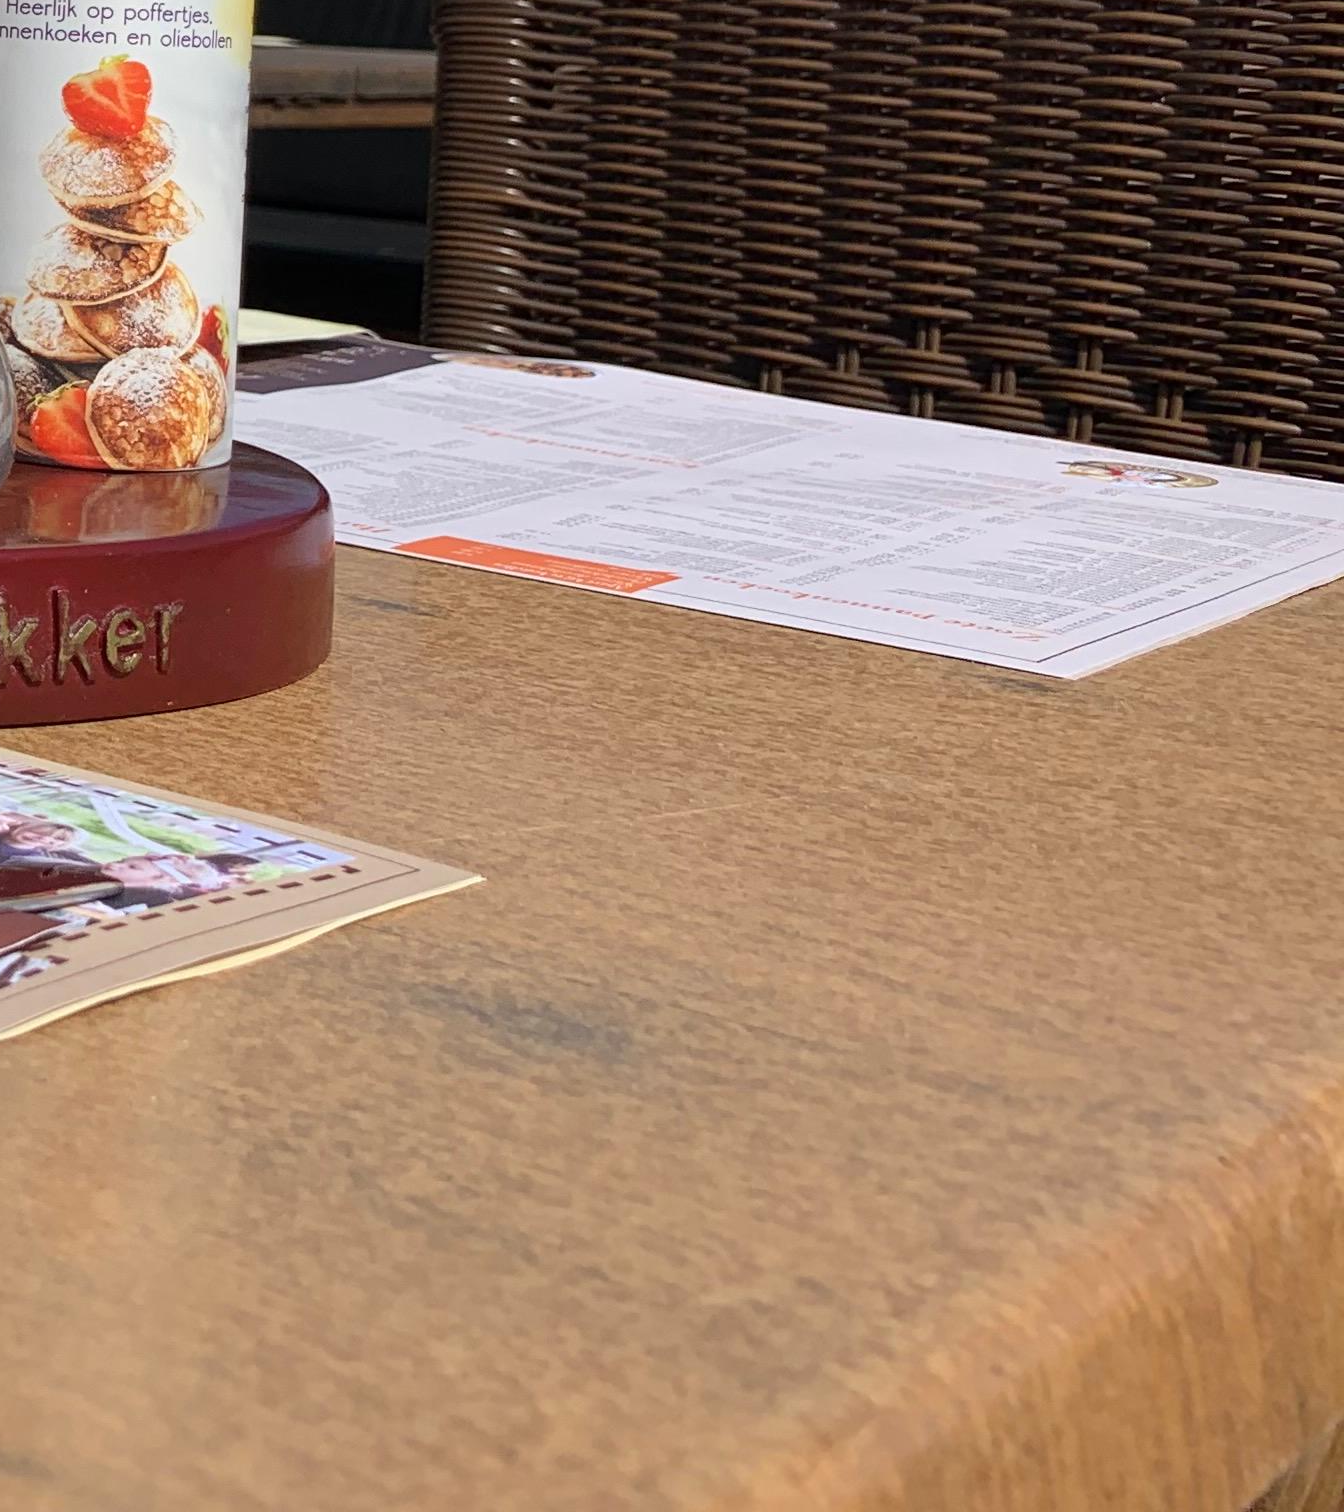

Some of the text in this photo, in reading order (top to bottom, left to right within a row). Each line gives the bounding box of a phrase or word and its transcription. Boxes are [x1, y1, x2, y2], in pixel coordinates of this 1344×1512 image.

[87, 5, 114, 24] op
[127, 32, 152, 46] en
[160, 29, 233, 49] oliebollen
